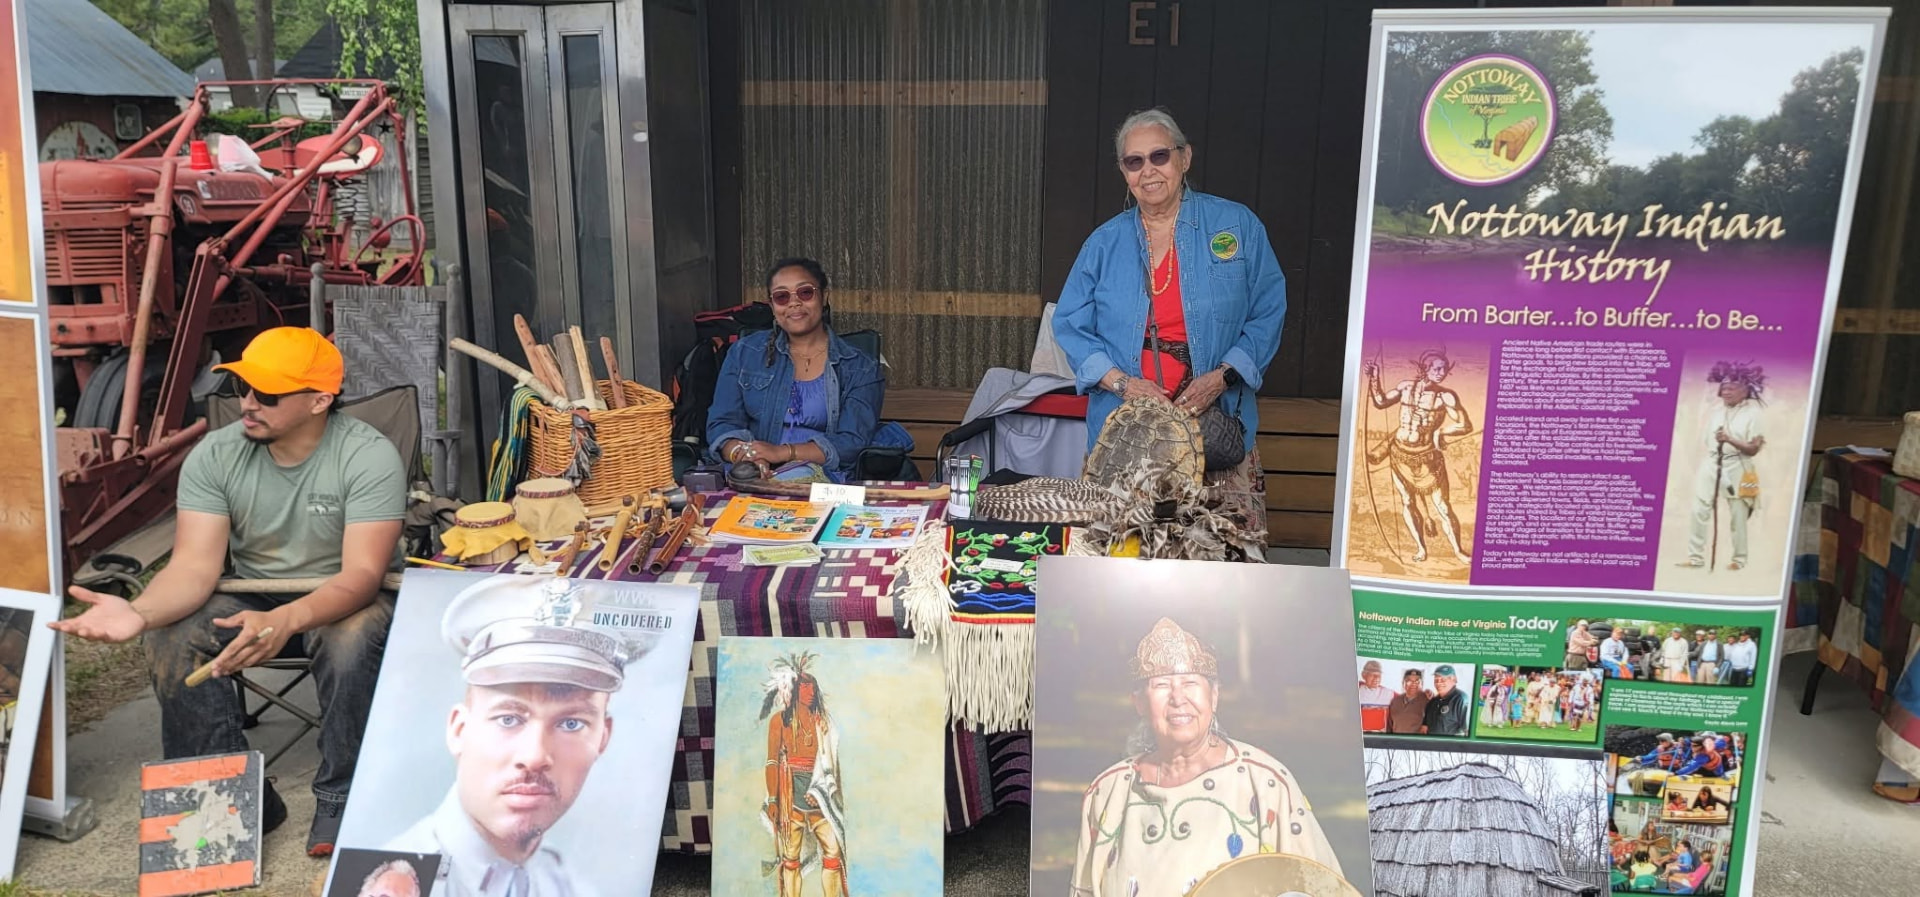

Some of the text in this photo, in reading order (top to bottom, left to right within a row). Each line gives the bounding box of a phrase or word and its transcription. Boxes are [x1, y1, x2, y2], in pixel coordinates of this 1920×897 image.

[1129, 2, 1180, 46] E1
[1444, 68, 1542, 104] NOTTOWAY
[1462, 94, 1518, 104] INDIAN TRIBE
[1426, 199, 1786, 258] Nottoway Indian
[1524, 246, 1671, 305] History
[1422, 303, 1478, 324] From
[1728, 311, 1783, 330] Be...
[594, 612, 672, 629] UNCOVERED
[1359, 612, 1560, 632] Nottoway Indian Tribe of Virginia Today
